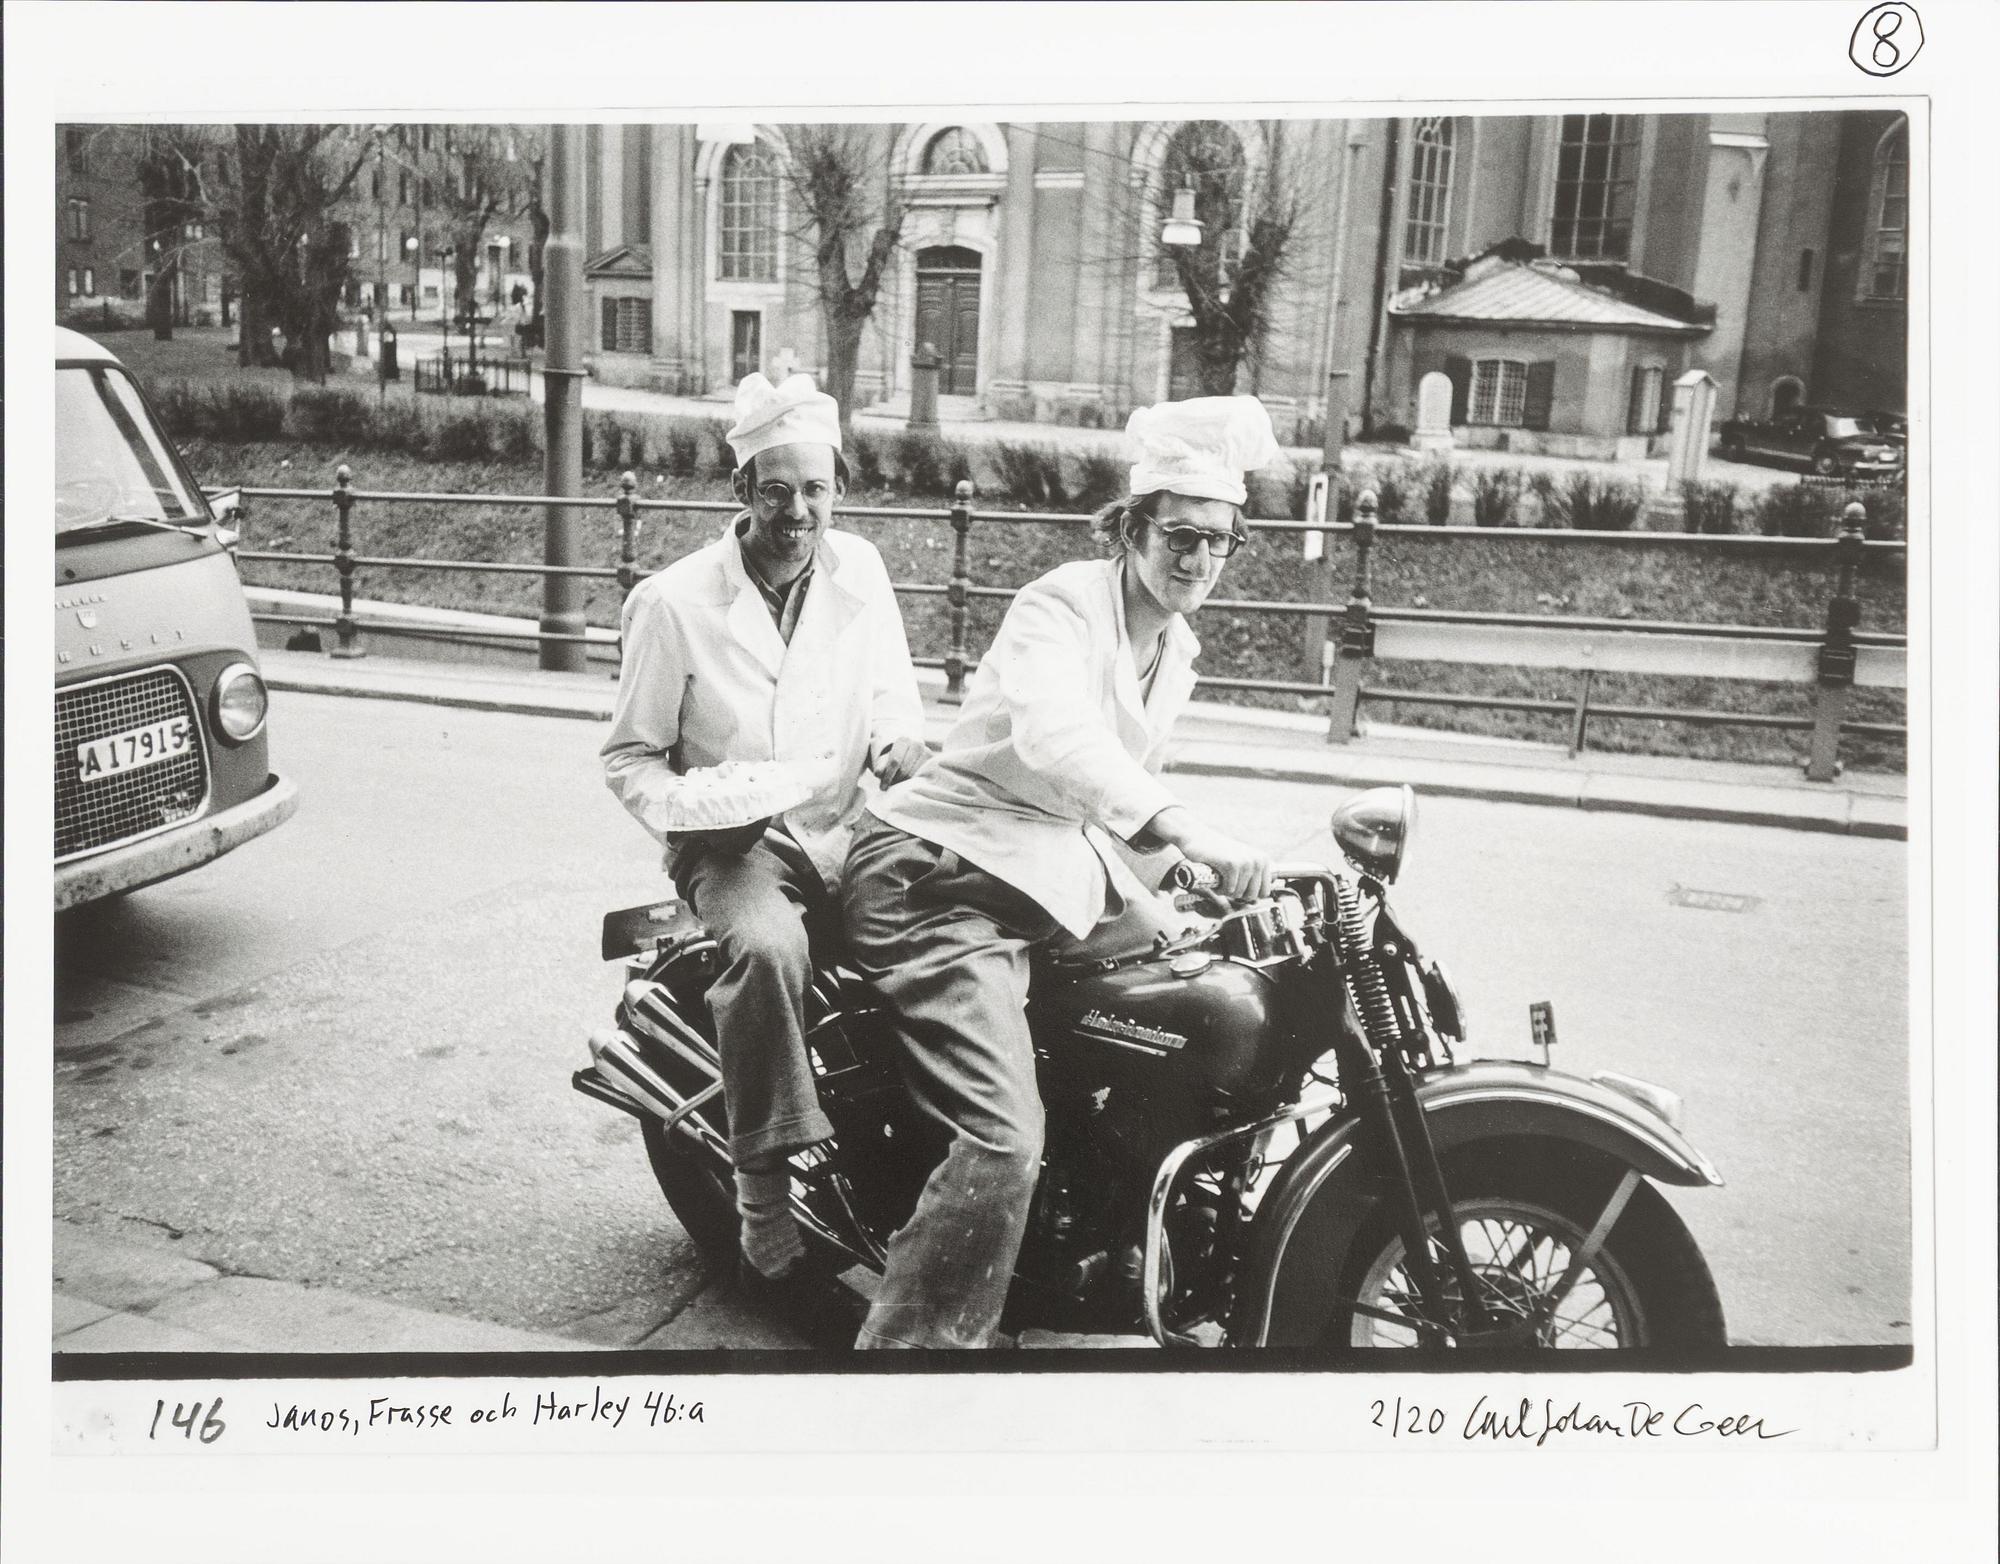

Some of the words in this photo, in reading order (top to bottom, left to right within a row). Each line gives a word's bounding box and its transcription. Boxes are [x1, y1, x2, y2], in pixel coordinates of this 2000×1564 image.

[1872, 10, 1903, 68] 8
[85, 722, 187, 776] A17915
[149, 1396, 226, 1444] 146
[266, 1402, 359, 1436] Janos,
[368, 1397, 453, 1428] Frasse
[470, 1392, 517, 1424] och
[533, 1385, 630, 1429] Harley
[1371, 1396, 1446, 1438] 2/20
[1463, 1395, 1537, 1440] Carl
[1536, 1398, 1625, 1447] Johan
[1622, 1401, 1664, 1437] De
[1673, 1403, 1801, 1439] Geer
